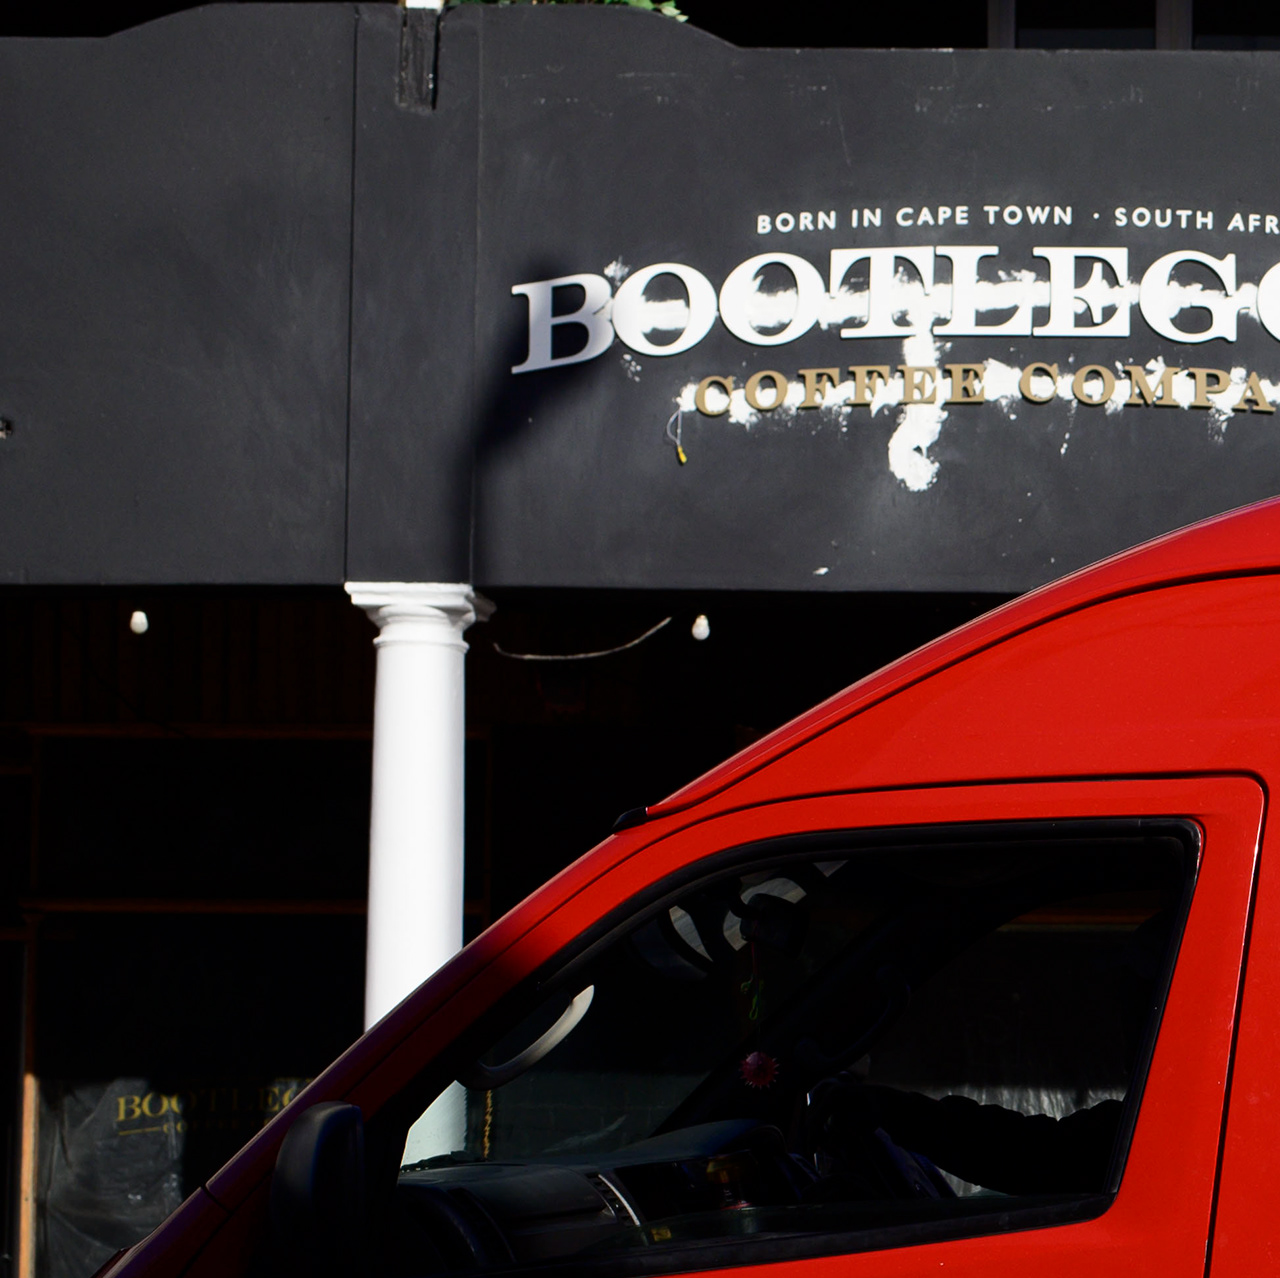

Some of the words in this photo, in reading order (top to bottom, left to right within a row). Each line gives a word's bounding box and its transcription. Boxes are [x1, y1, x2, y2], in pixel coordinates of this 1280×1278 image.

[757, 213, 837, 235] BORN
[851, 208, 882, 229] IN
[896, 205, 969, 228] CAPE
[983, 204, 1073, 226] TOWN
[1114, 206, 1214, 231] SOUTH
[694, 362, 987, 417] COFFEE
